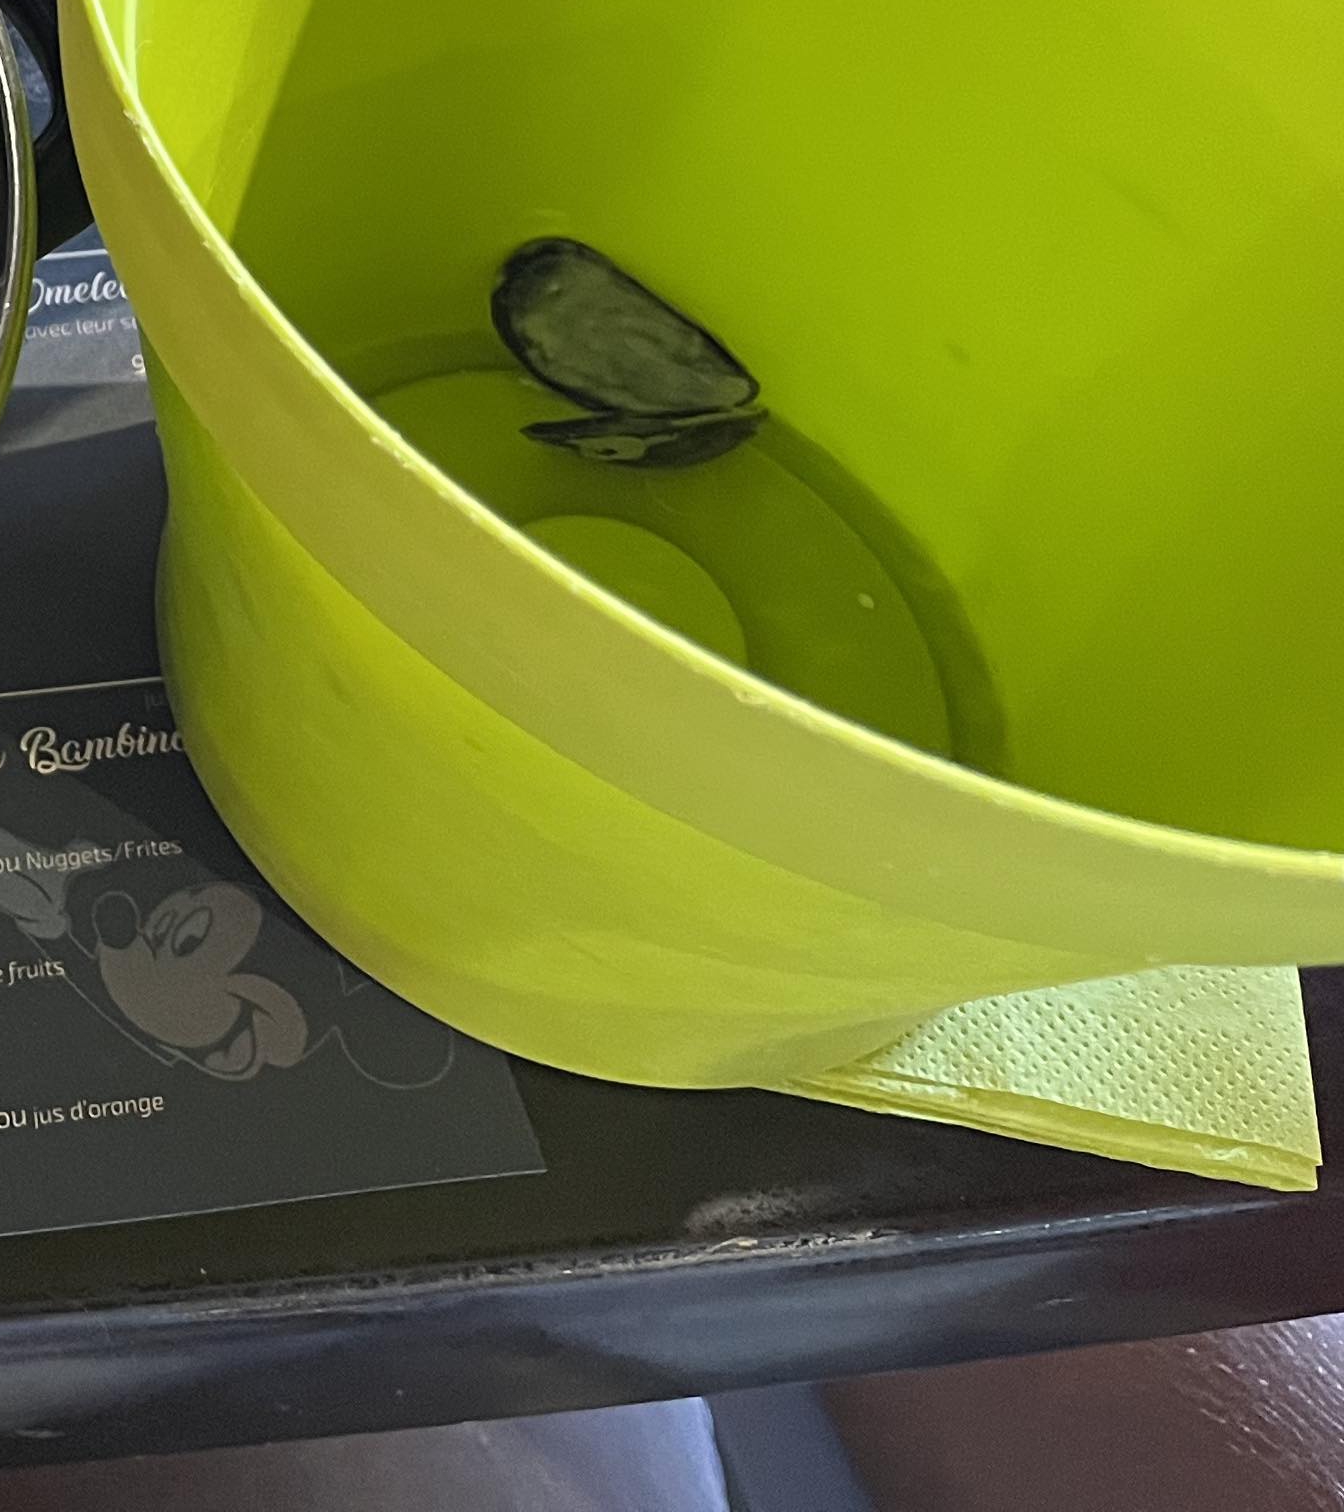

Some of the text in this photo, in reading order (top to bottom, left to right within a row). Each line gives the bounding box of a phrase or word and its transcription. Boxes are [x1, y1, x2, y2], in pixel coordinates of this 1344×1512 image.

[76, 318, 114, 335] leur
[7, 959, 65, 986] fruits
[32, 1106, 64, 1130] jus
[70, 1094, 165, 1121] d'orange
